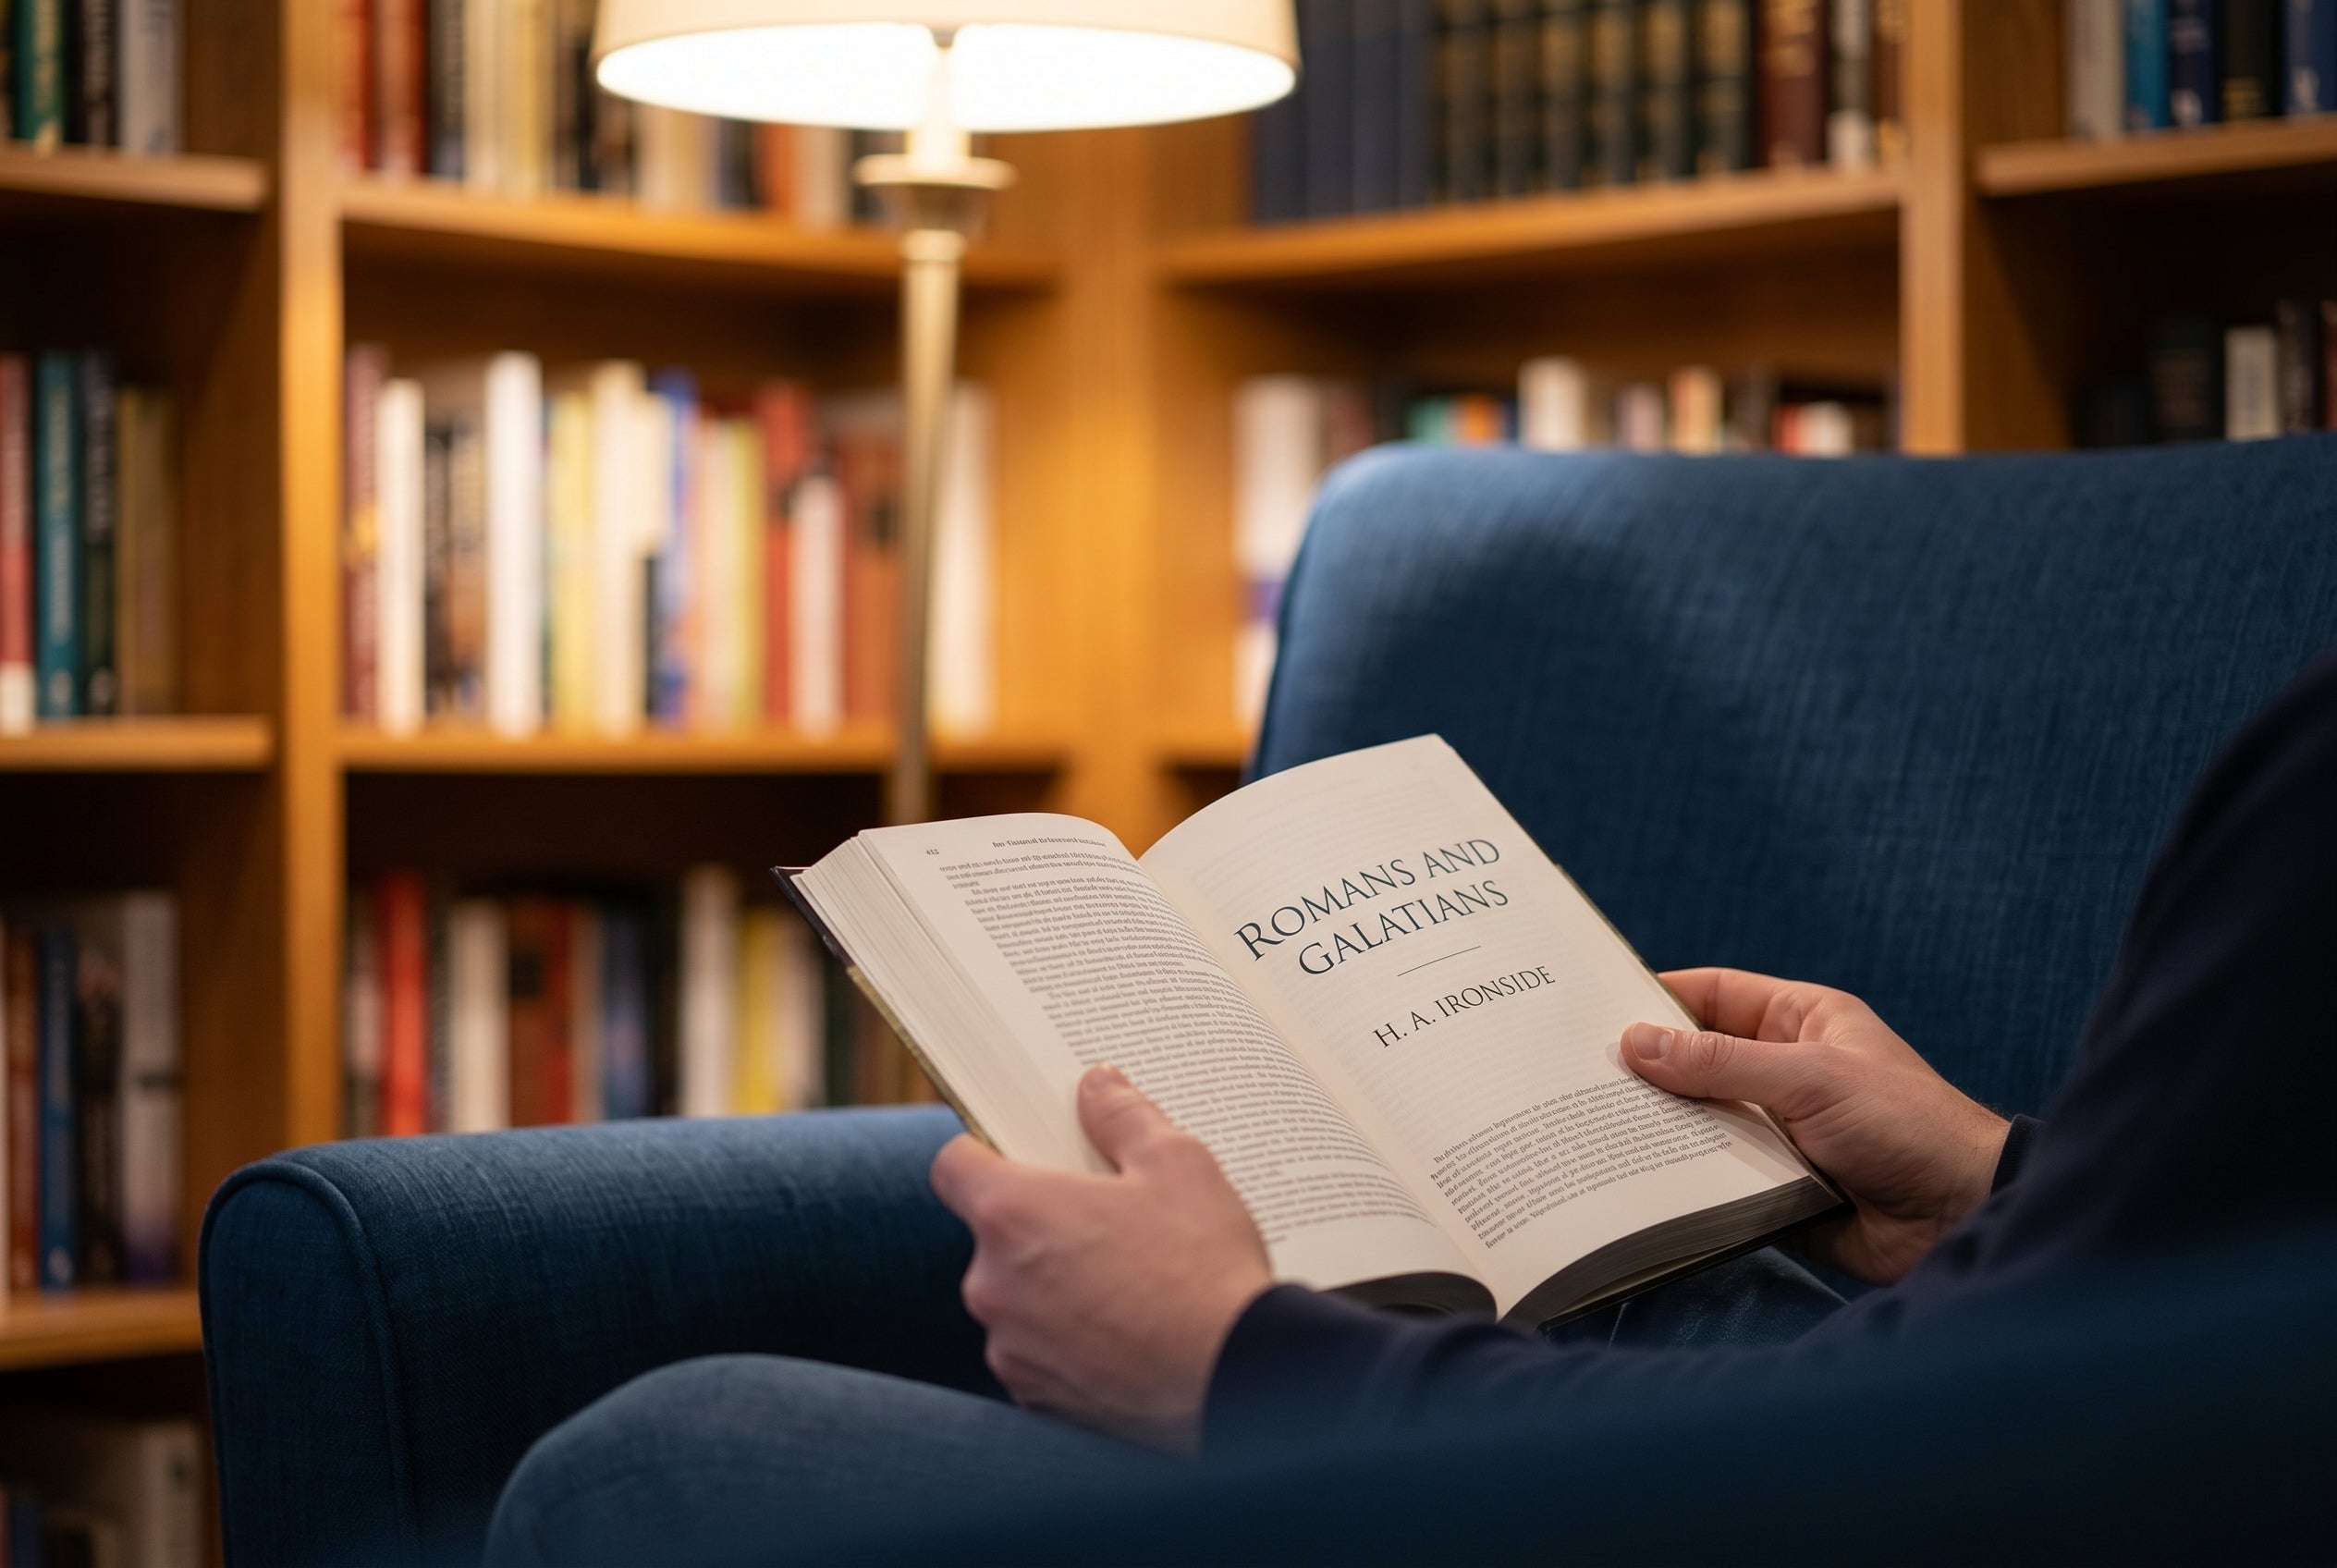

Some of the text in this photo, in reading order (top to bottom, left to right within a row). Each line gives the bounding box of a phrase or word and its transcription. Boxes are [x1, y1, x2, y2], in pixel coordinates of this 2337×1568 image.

[1234, 858, 1416, 962] ROMANS
[1423, 839, 1500, 879] AND
[1299, 879, 1509, 975] GALATIANS
[1373, 965, 1556, 1047] H. A. IRONSIDE
